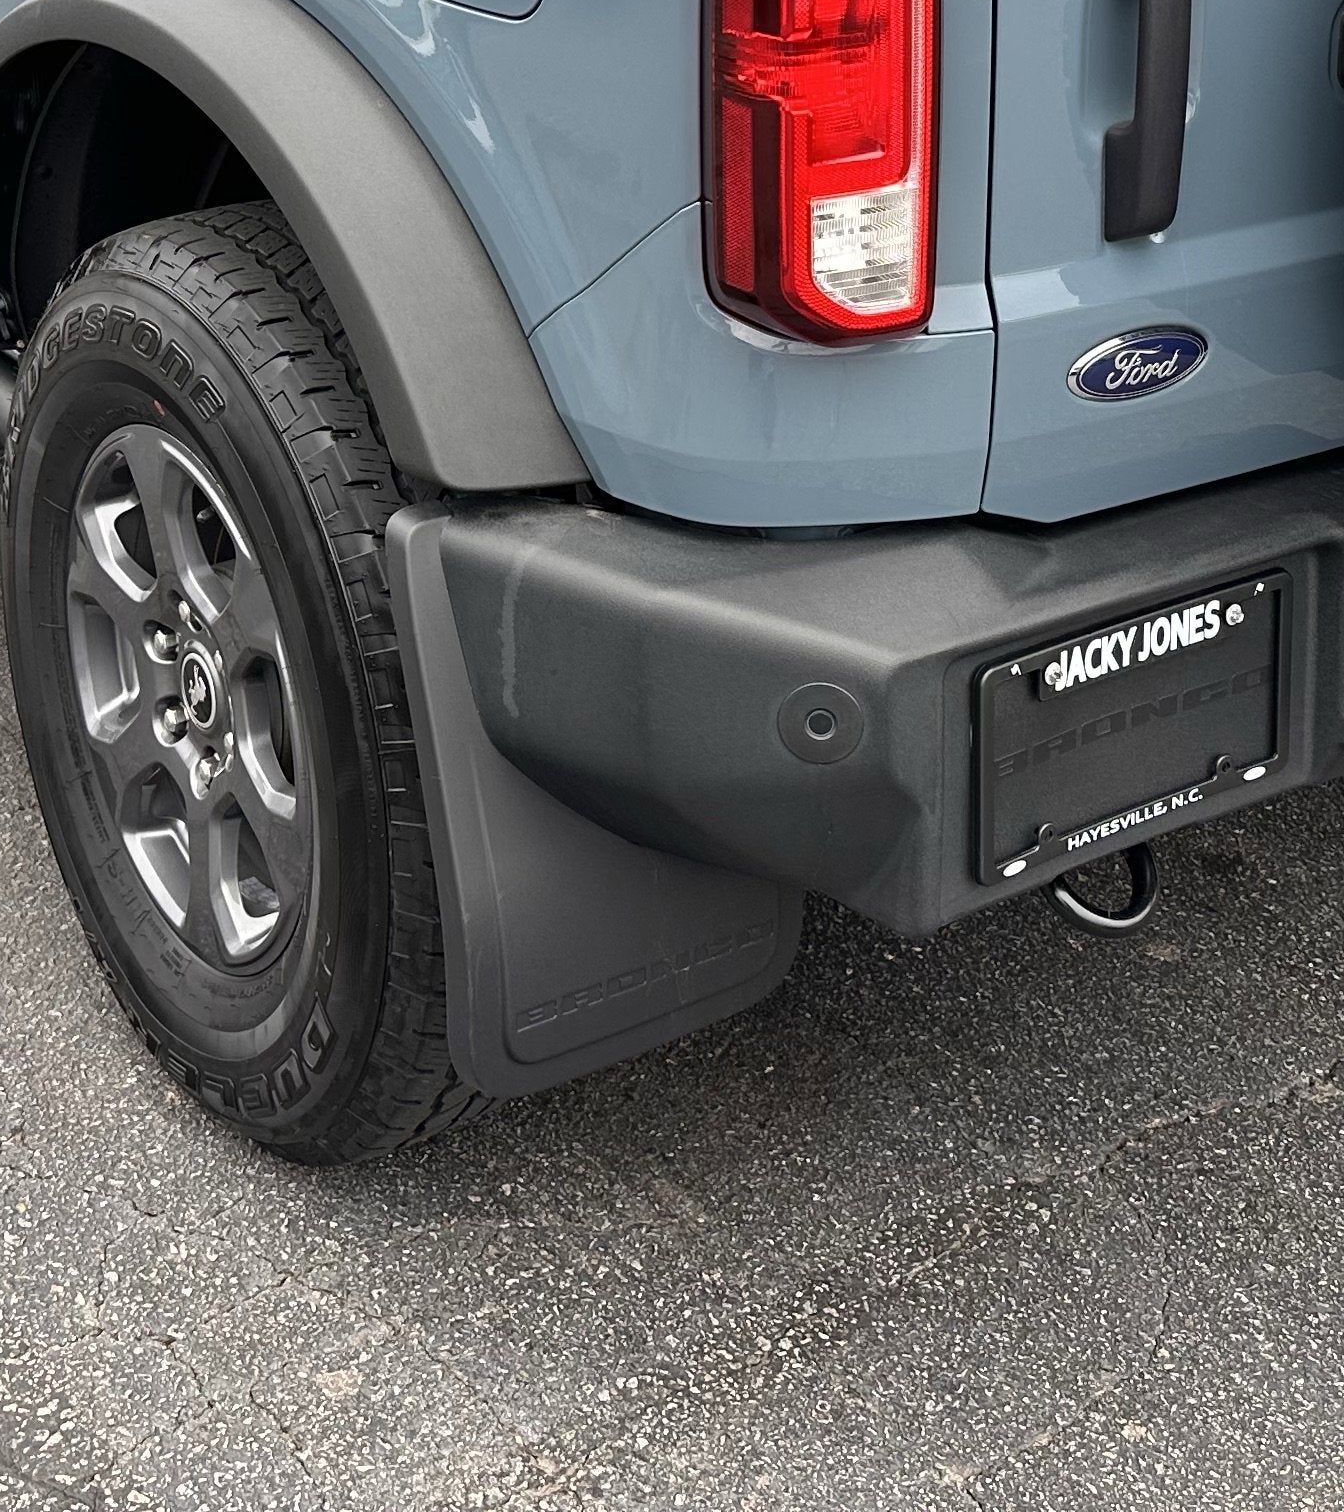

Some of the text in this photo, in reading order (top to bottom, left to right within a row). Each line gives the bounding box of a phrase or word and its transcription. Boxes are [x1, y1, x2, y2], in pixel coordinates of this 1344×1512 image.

[1105, 344, 1182, 389] Ford
[0, 303, 226, 526] IDGESTONE
[1054, 600, 1221, 691] JACKY JONES
[1066, 787, 1204, 852] HAYESVILLE, N.C.
